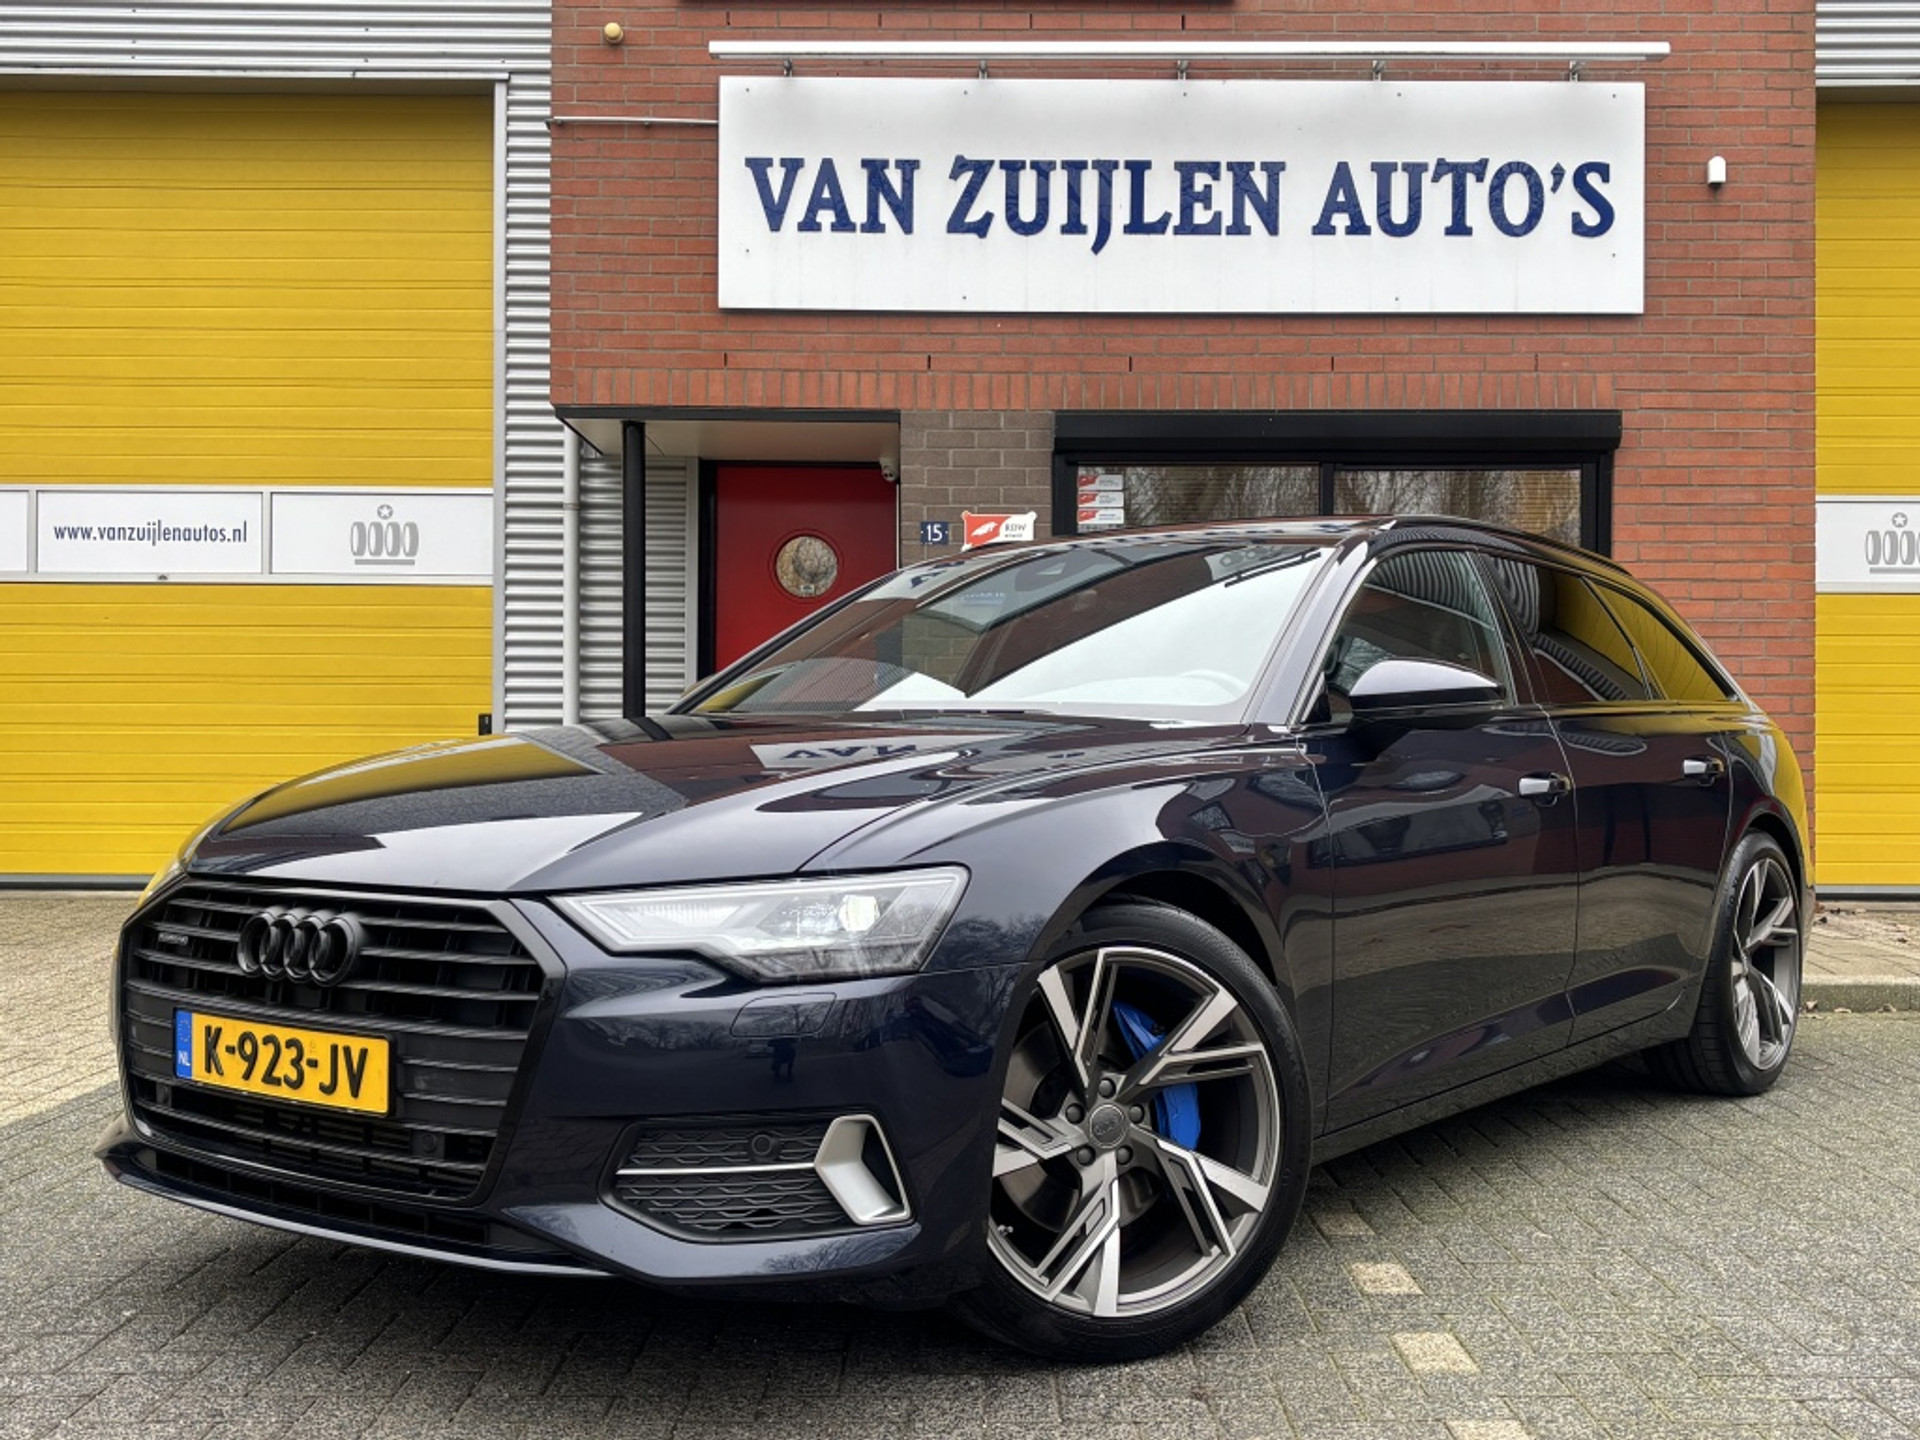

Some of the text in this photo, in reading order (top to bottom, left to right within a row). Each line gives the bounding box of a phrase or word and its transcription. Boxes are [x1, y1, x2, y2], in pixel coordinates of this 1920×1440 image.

[746, 155, 1616, 256] VAN ZUIJLEN AUTO'S
[53, 520, 248, 546] www.vanzuijlenautos.nl
[926, 524, 943, 543] 15
[178, 1051, 191, 1067] NL
[204, 1024, 369, 1099] K-923-JV
